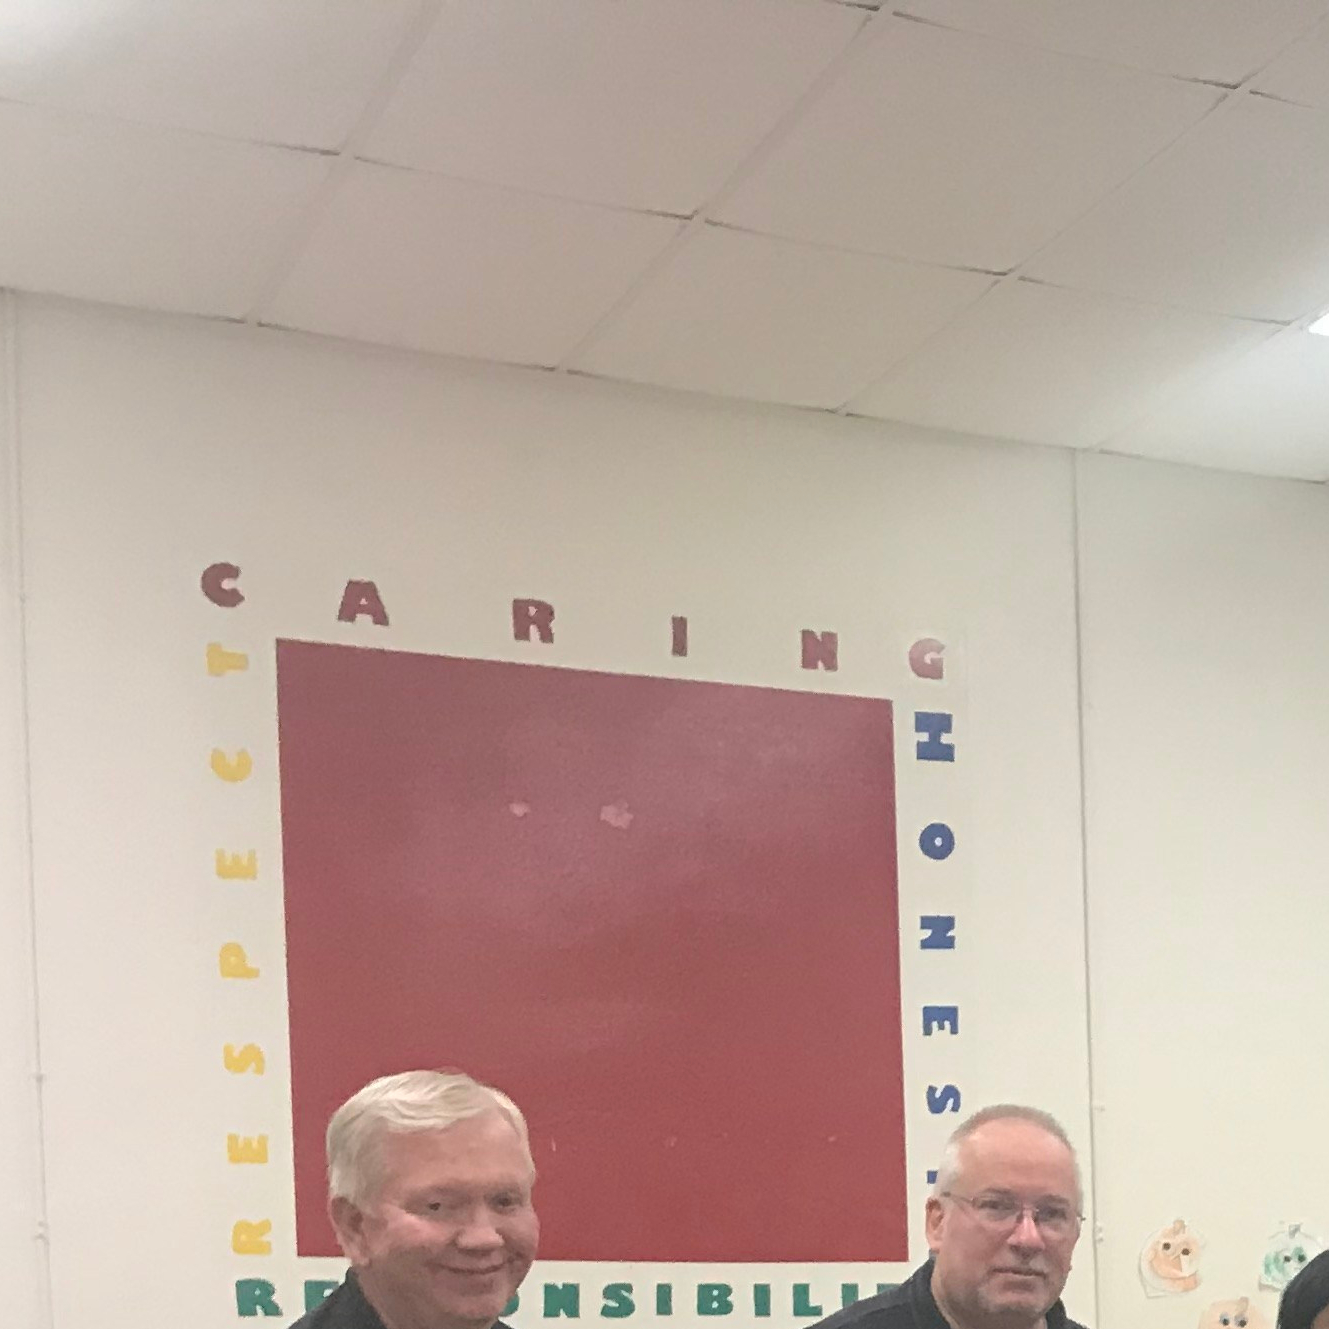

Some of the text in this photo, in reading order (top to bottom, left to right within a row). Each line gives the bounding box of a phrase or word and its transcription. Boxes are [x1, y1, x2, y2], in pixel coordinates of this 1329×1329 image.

[201, 562, 946, 680] CARING
[206, 642, 273, 1256] RESPECT
[914, 711, 962, 1184] HONES
[235, 1280, 903, 1318] RNSIBILI
